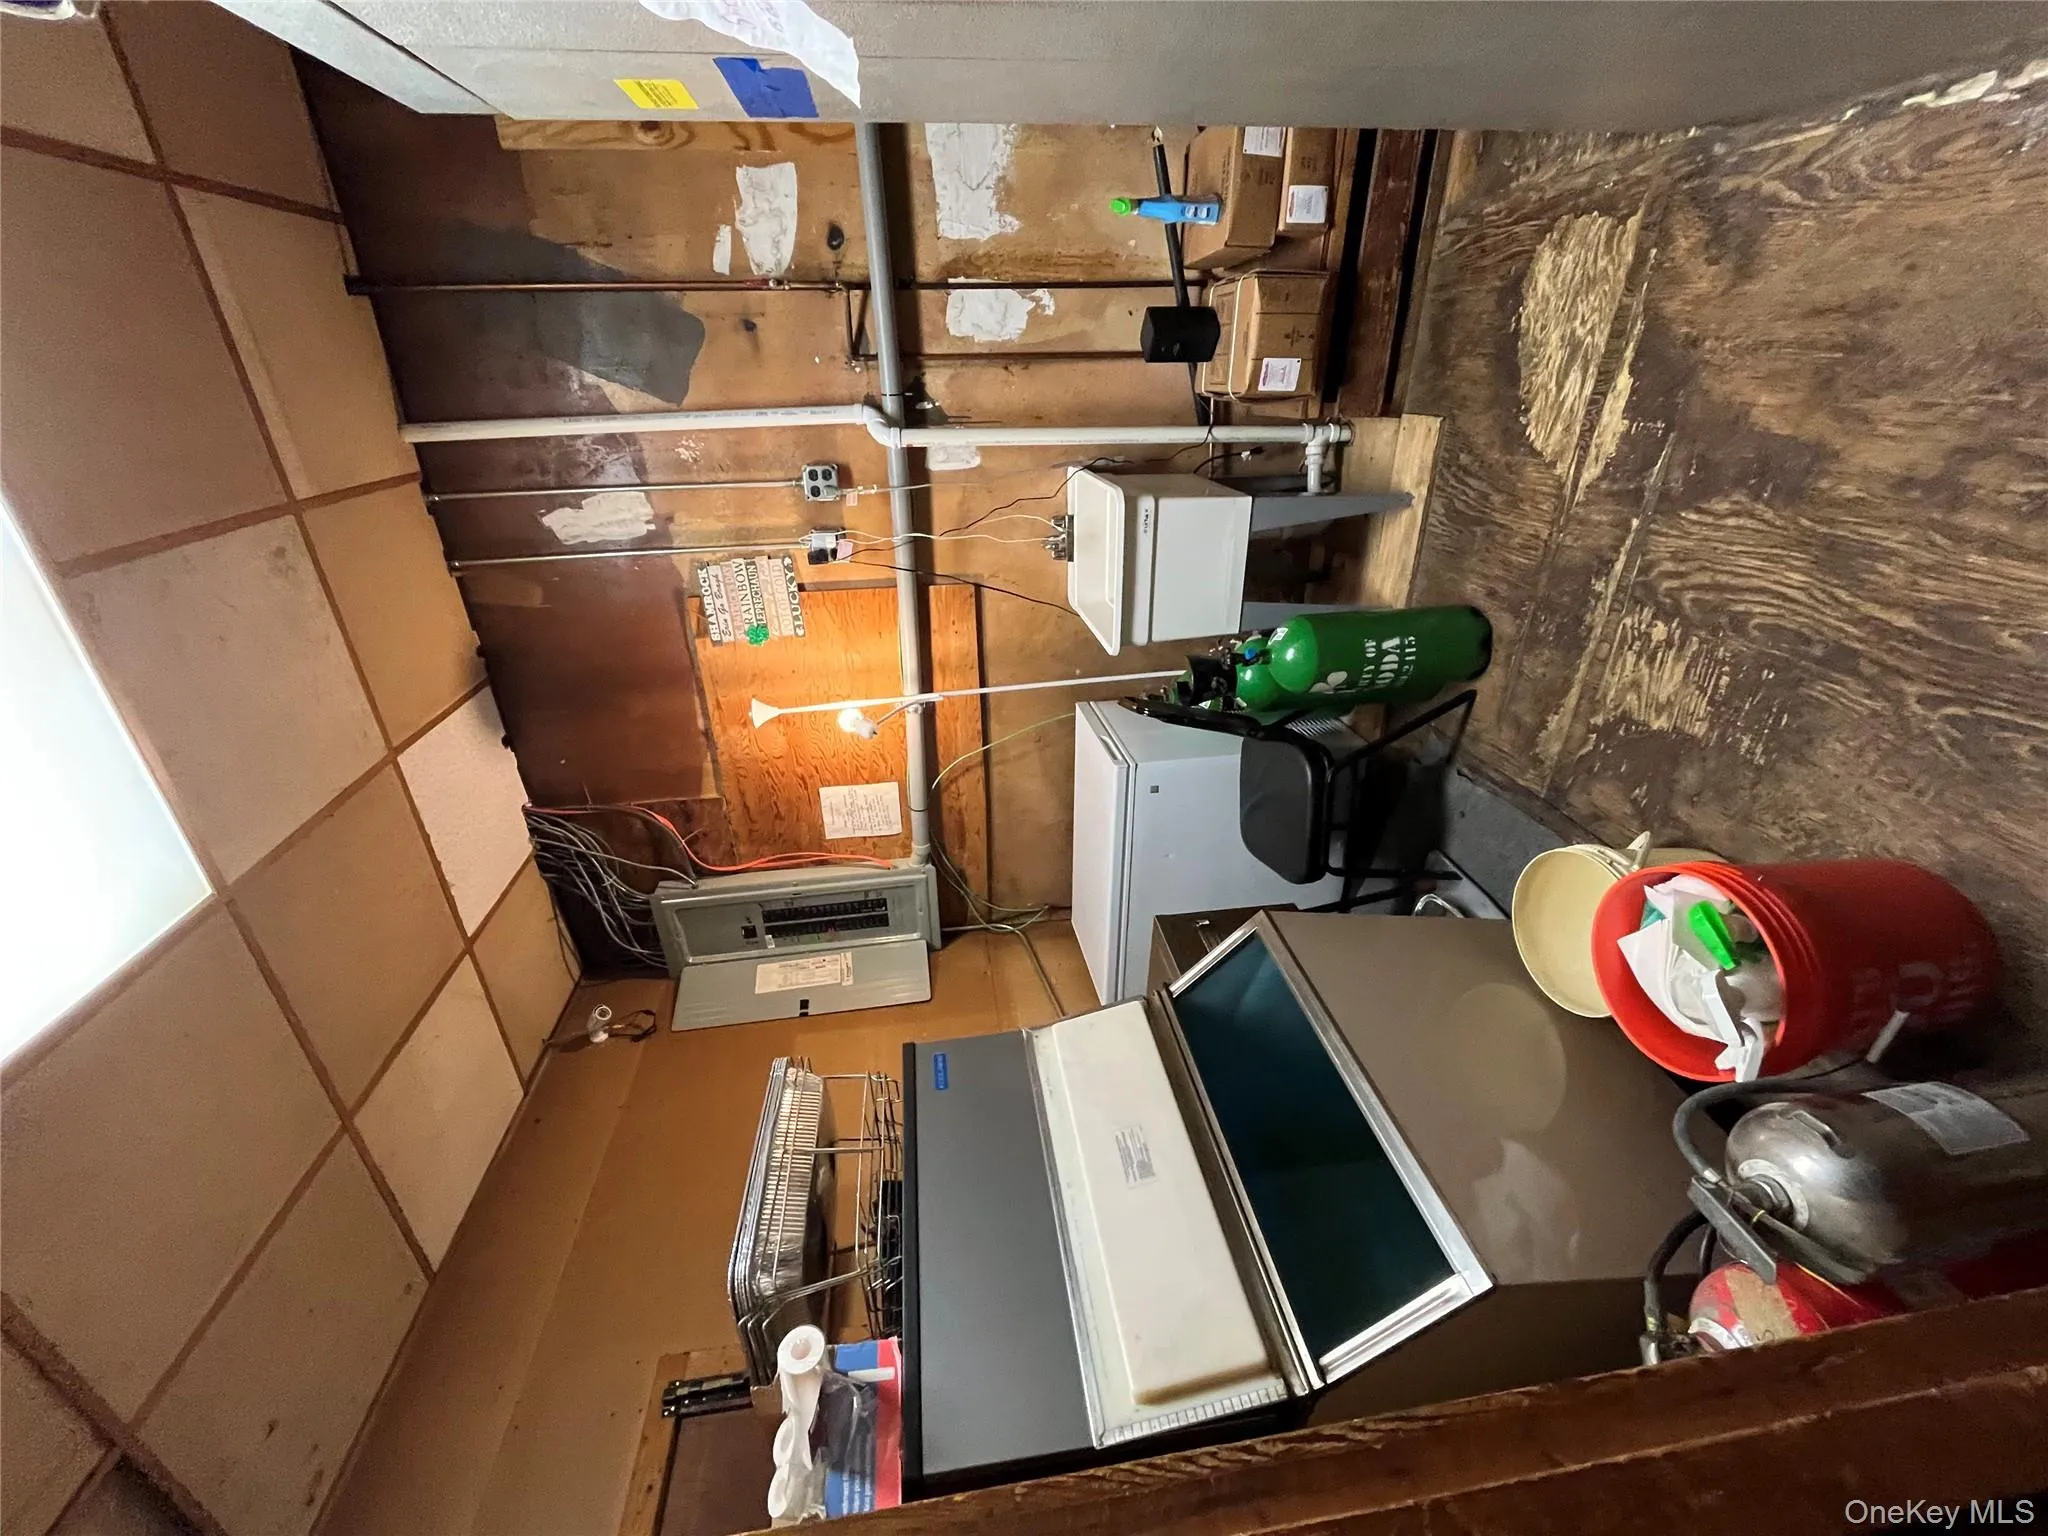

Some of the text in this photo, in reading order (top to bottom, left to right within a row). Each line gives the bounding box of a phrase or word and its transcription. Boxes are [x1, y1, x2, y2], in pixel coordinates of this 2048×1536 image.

[697, 567, 721, 641] SHAMROCK
[717, 603, 729, 615] Go
[732, 561, 753, 625] RAINBOW
[747, 565, 767, 625] LEPRECHAUN
[785, 567, 804, 626] LUCKY
[721, 618, 732, 637] Erin
[1364, 638, 1377, 658] OF
[1374, 636, 1401, 688] ODA
